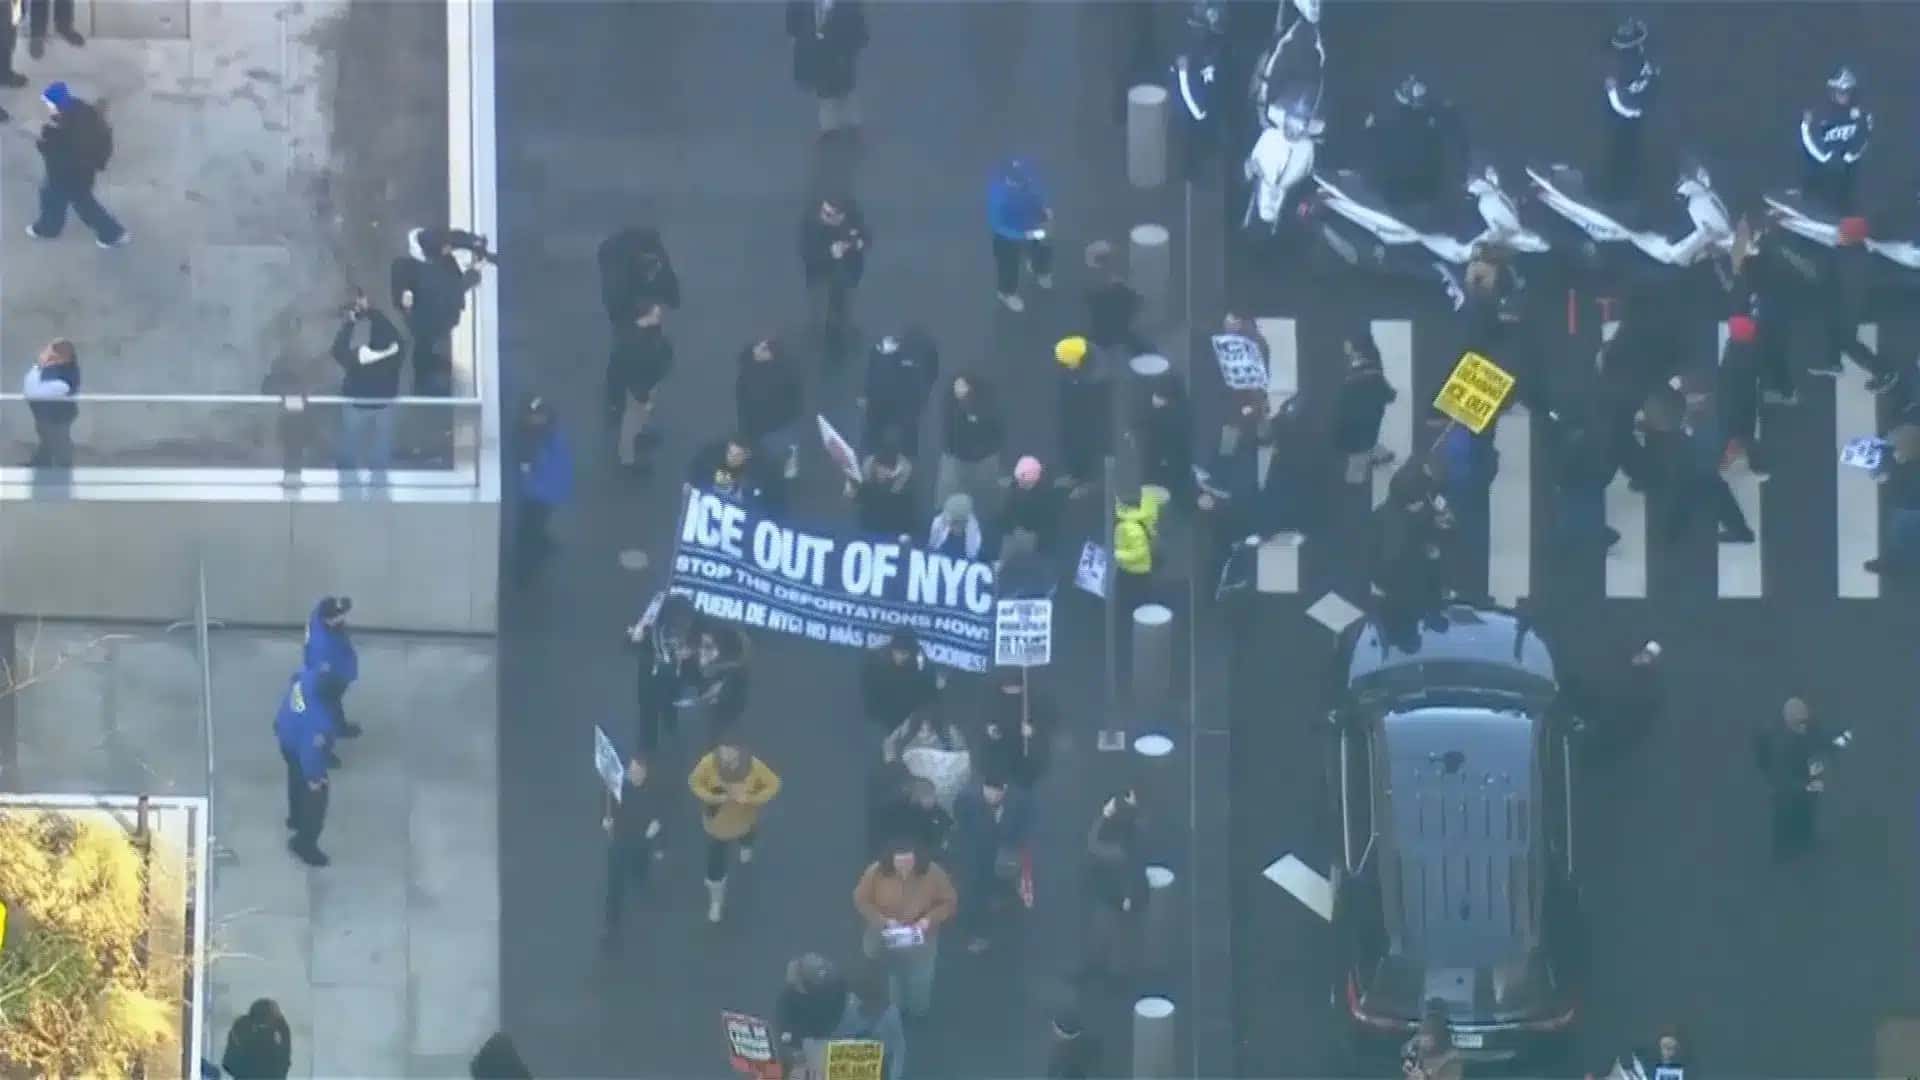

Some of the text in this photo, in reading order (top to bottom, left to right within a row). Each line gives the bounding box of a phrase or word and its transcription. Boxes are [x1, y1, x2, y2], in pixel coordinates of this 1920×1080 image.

[682, 487, 993, 614] ICE OUT OF NYC
[675, 555, 732, 579] STOP
[736, 569, 771, 593] THE
[774, 583, 931, 628] DEPORTATIONS
[694, 591, 744, 622] FUERA
[744, 603, 767, 627] DE
[805, 620, 828, 641] NO
